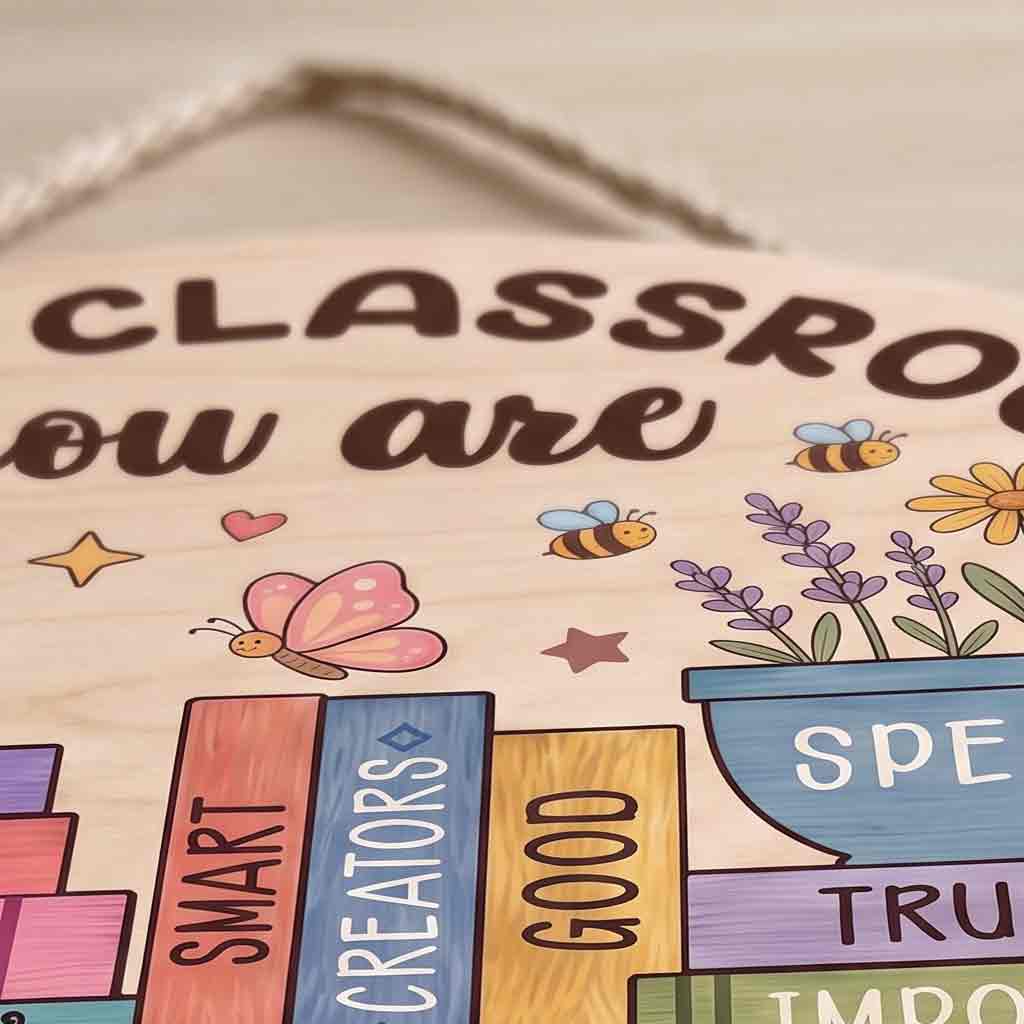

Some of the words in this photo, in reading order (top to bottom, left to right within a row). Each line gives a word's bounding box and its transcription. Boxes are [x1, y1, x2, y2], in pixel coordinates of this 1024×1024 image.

[0, 410, 279, 479] ou
[341, 386, 716, 470] are
[169, 797, 287, 966] SMART
[335, 756, 449, 1013] CREATORS
[521, 789, 641, 951] GOOD
